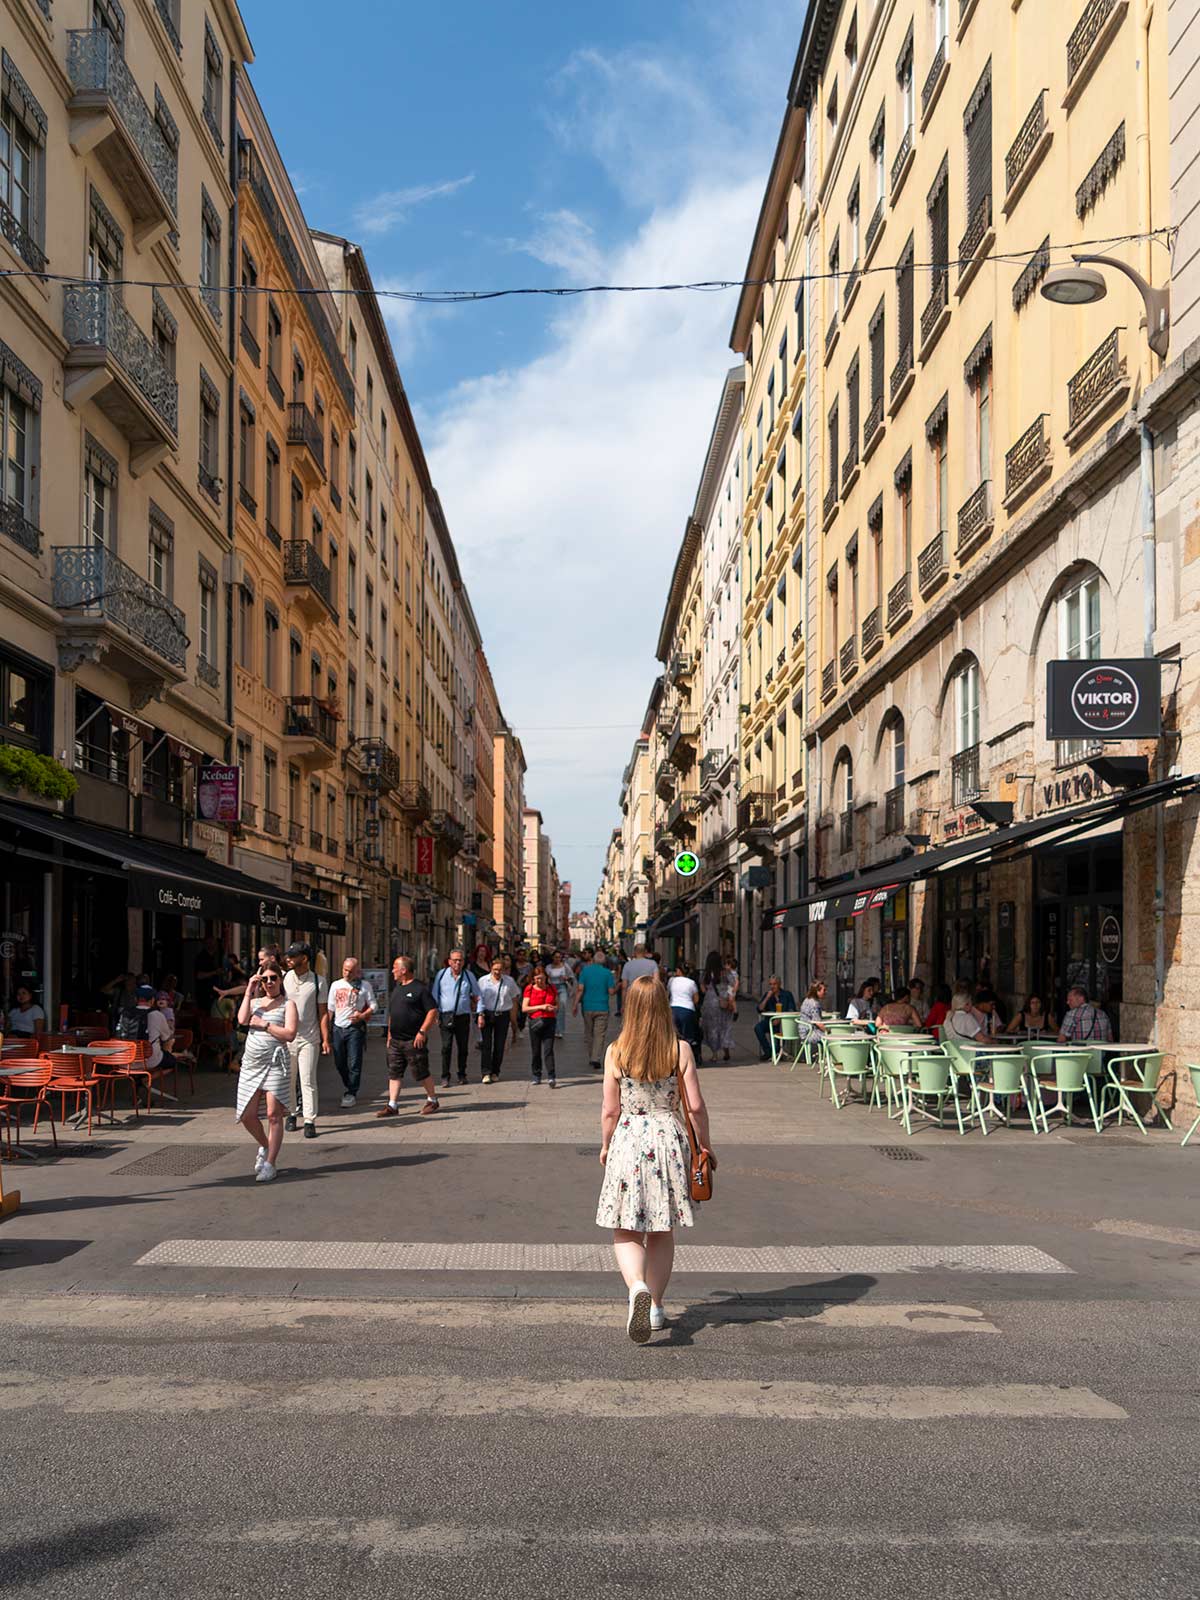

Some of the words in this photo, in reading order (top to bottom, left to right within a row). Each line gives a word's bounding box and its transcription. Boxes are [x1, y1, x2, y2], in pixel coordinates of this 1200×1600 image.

[1077, 692, 1133, 705] VIKTOR
[202, 770, 235, 781] Kebab
[1043, 772, 1103, 808] VIKTOR
